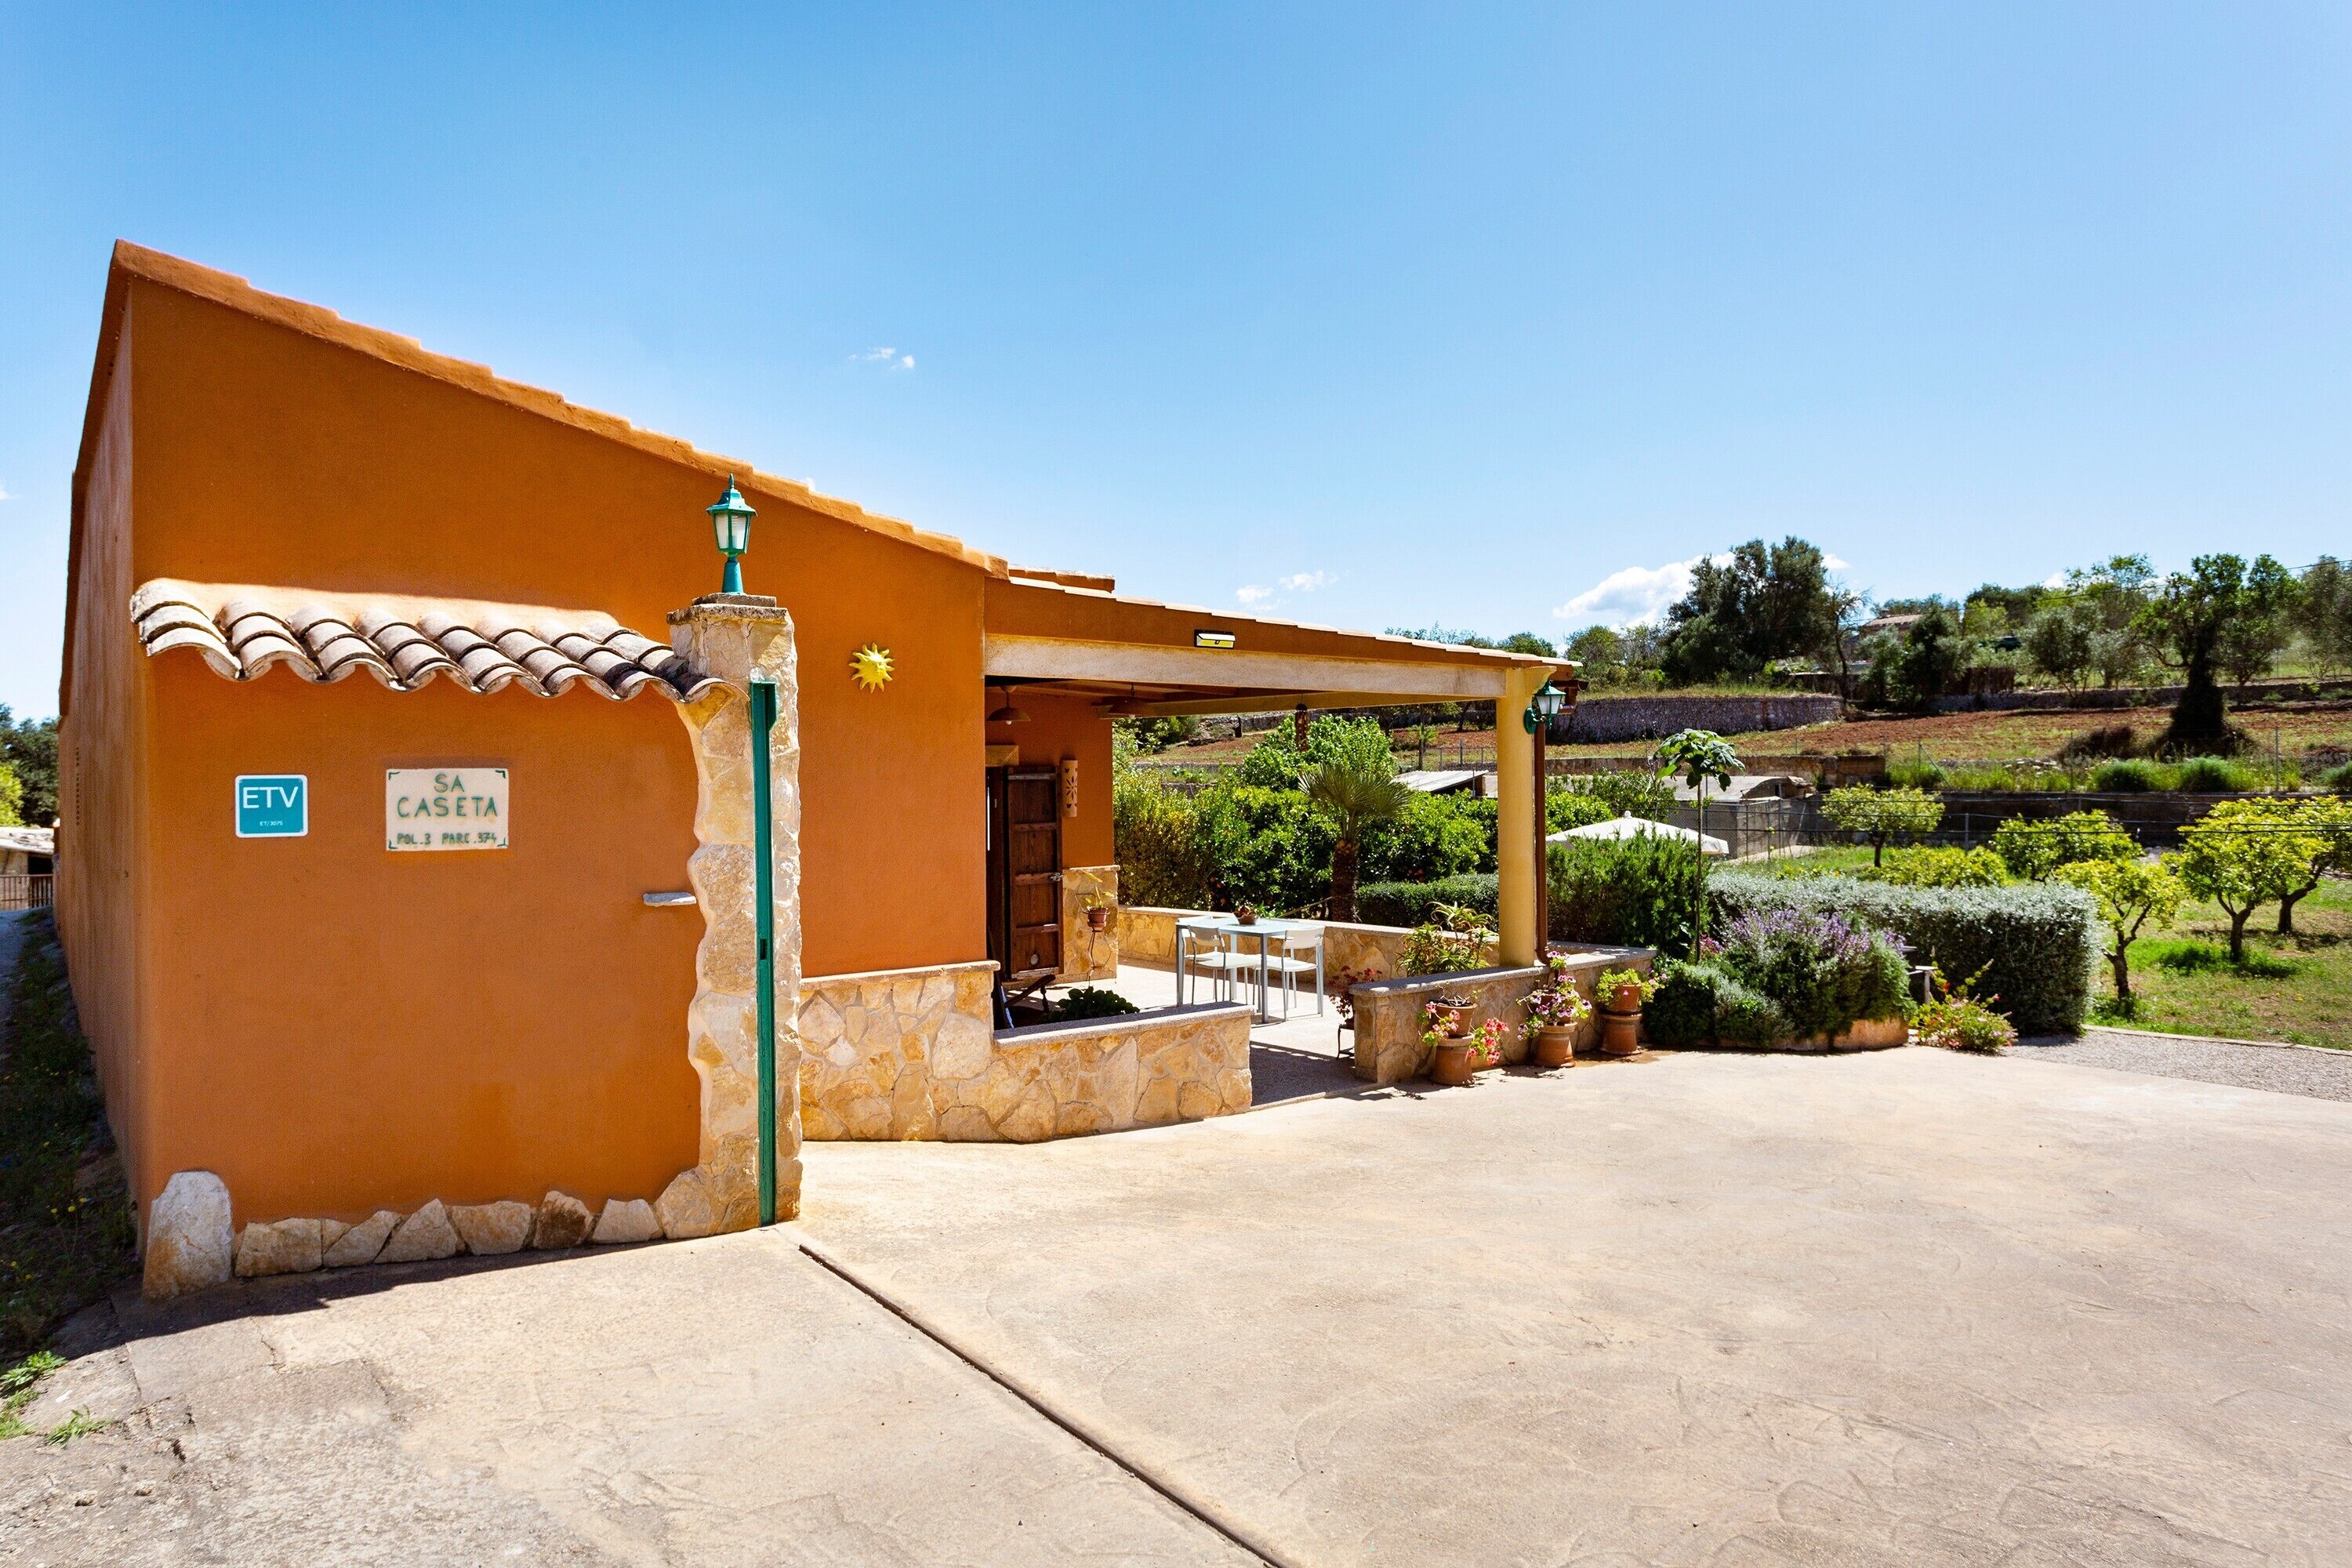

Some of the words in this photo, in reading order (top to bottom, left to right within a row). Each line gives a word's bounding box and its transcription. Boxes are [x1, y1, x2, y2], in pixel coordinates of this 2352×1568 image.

[434, 773, 465, 793] SA
[243, 786, 299, 808] ETV
[397, 797, 498, 818] CASETA
